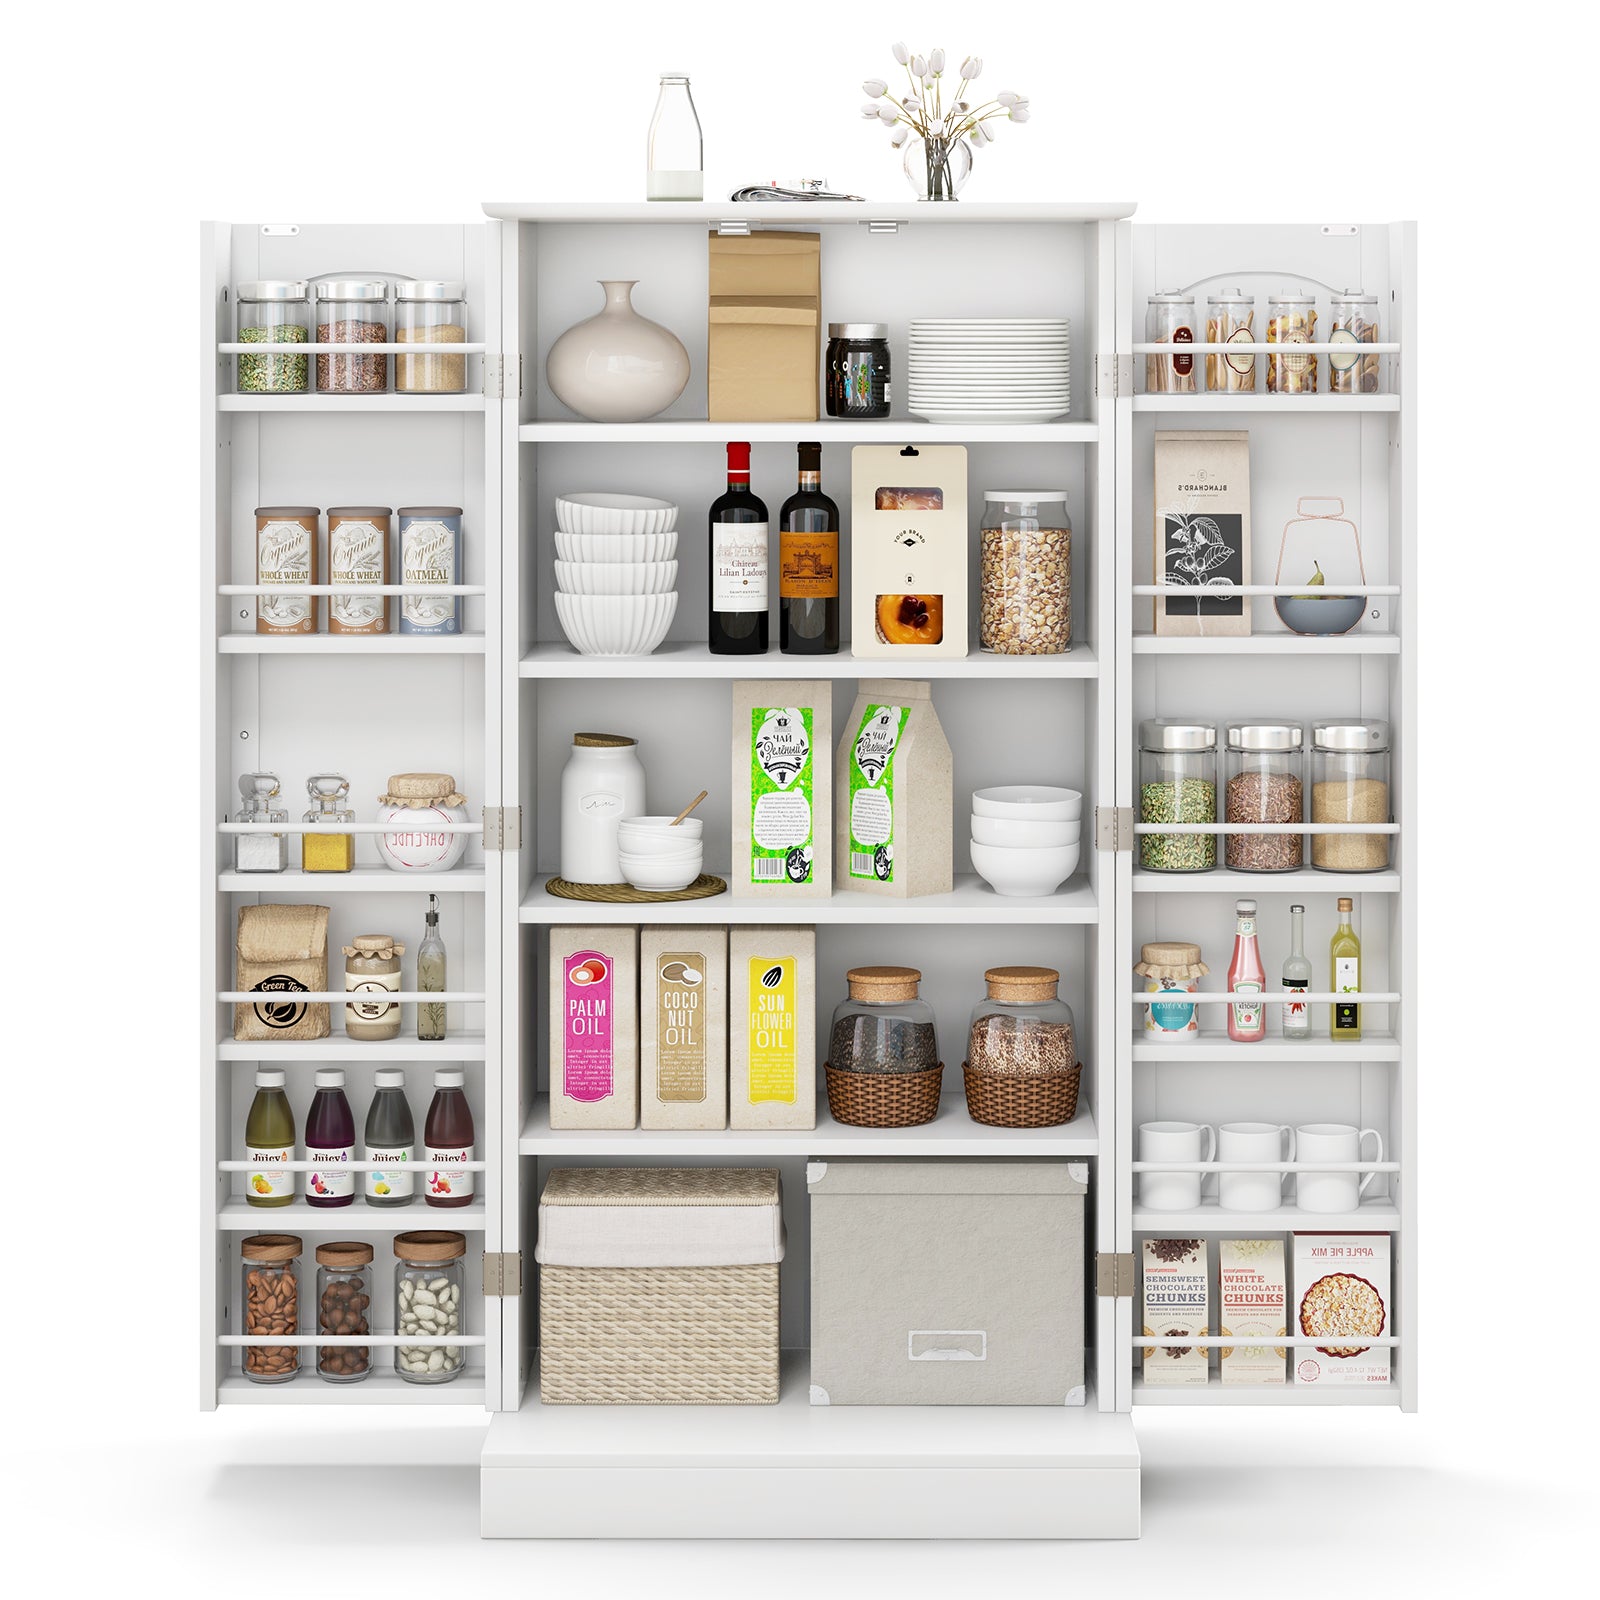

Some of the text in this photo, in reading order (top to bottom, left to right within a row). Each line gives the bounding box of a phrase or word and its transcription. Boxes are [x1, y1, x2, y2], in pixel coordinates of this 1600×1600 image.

[894, 529, 926, 543] YOUR BRAND
[260, 533, 304, 567] Organic
[333, 533, 377, 567] Organic
[404, 533, 448, 567] Organic
[260, 571, 309, 580] WHOLE WHEAT
[333, 571, 381, 580] WHOLE WHEAT
[405, 569, 448, 580] OATMEAL
[719, 568, 740, 577] Lilian
[773, 733, 792, 742] ЧАЙ
[261, 982, 302, 992] Green Tea
[570, 1000, 606, 1016] PALM
[664, 992, 698, 1009] COCO
[758, 994, 784, 1011] SUN
[668, 1010, 694, 1026] NUT
[752, 1012, 792, 1030] FLOWER
[572, 1018, 604, 1035] OIL
[666, 1028, 697, 1045] OIL
[756, 1030, 788, 1048] OIL
[1146, 1294, 1206, 1302] CHUNKS
[1224, 1294, 1284, 1302] CHUNKS
